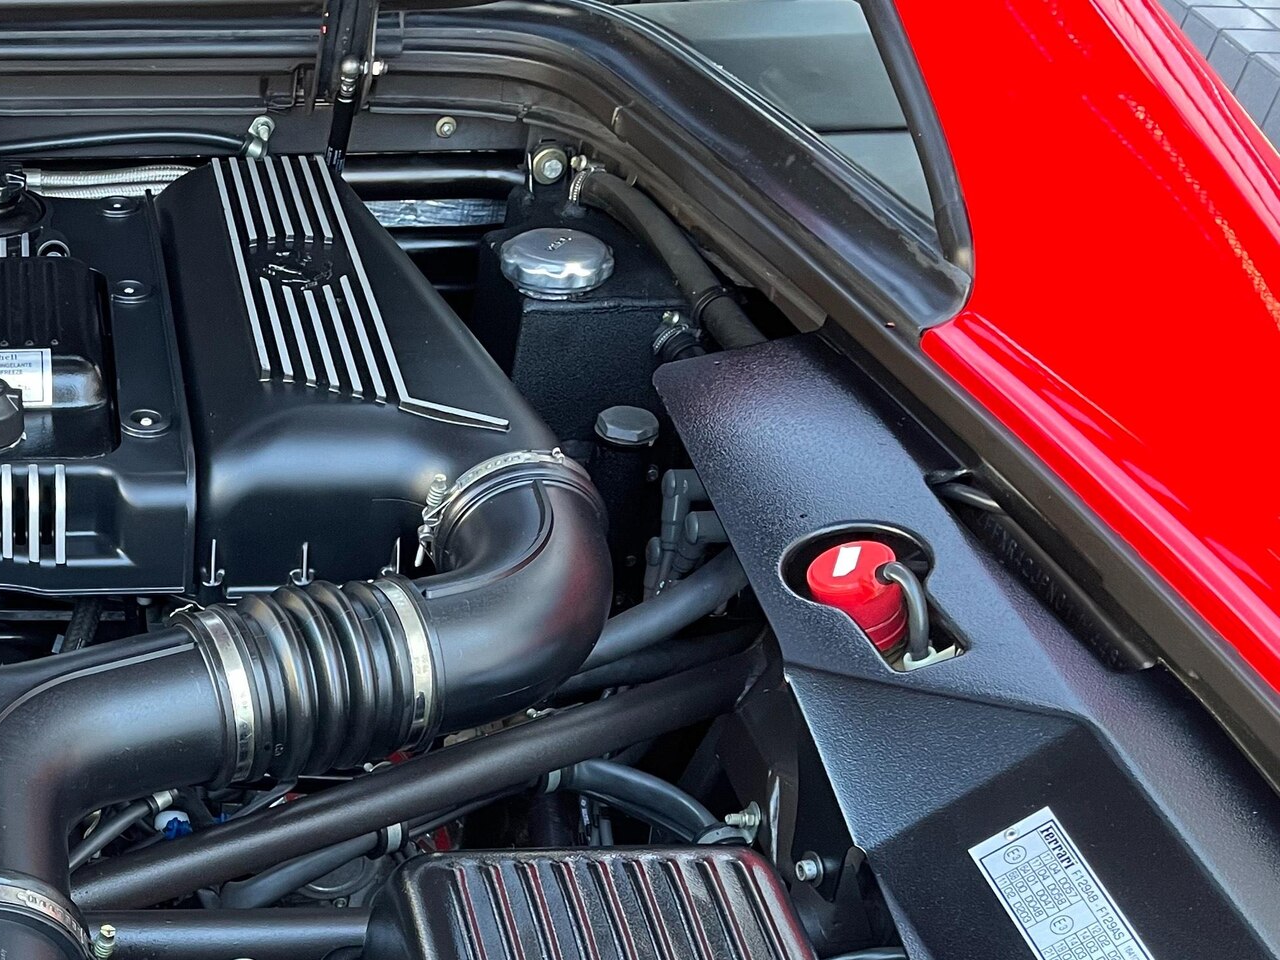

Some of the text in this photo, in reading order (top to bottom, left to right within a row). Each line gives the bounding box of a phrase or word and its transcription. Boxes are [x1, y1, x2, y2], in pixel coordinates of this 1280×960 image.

[1040, 825, 1078, 870] Ferrari
[1071, 869, 1099, 903] F129AB
[1096, 906, 1125, 941] F129AS
